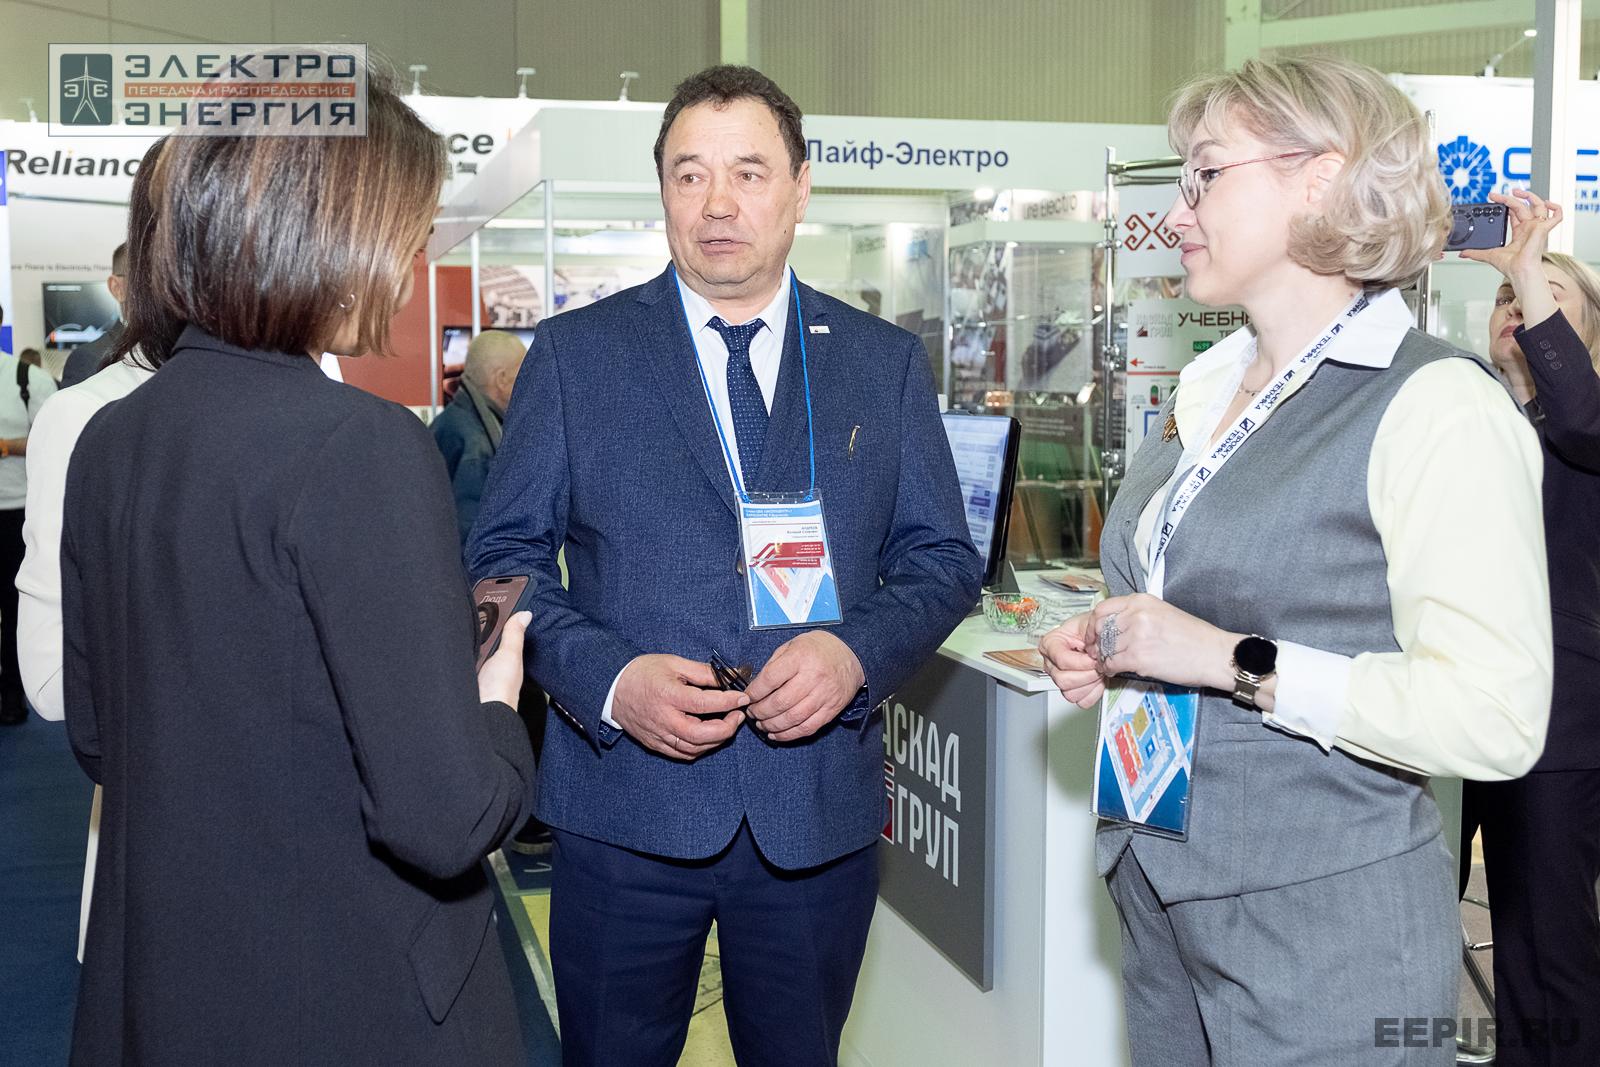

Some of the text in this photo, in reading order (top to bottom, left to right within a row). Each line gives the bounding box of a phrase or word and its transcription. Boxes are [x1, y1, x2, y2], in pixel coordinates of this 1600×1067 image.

[7, 149, 141, 176] Relianc
[1222, 431, 1246, 460] ПРОЕКТ
[897, 784, 959, 888] ГРУП
